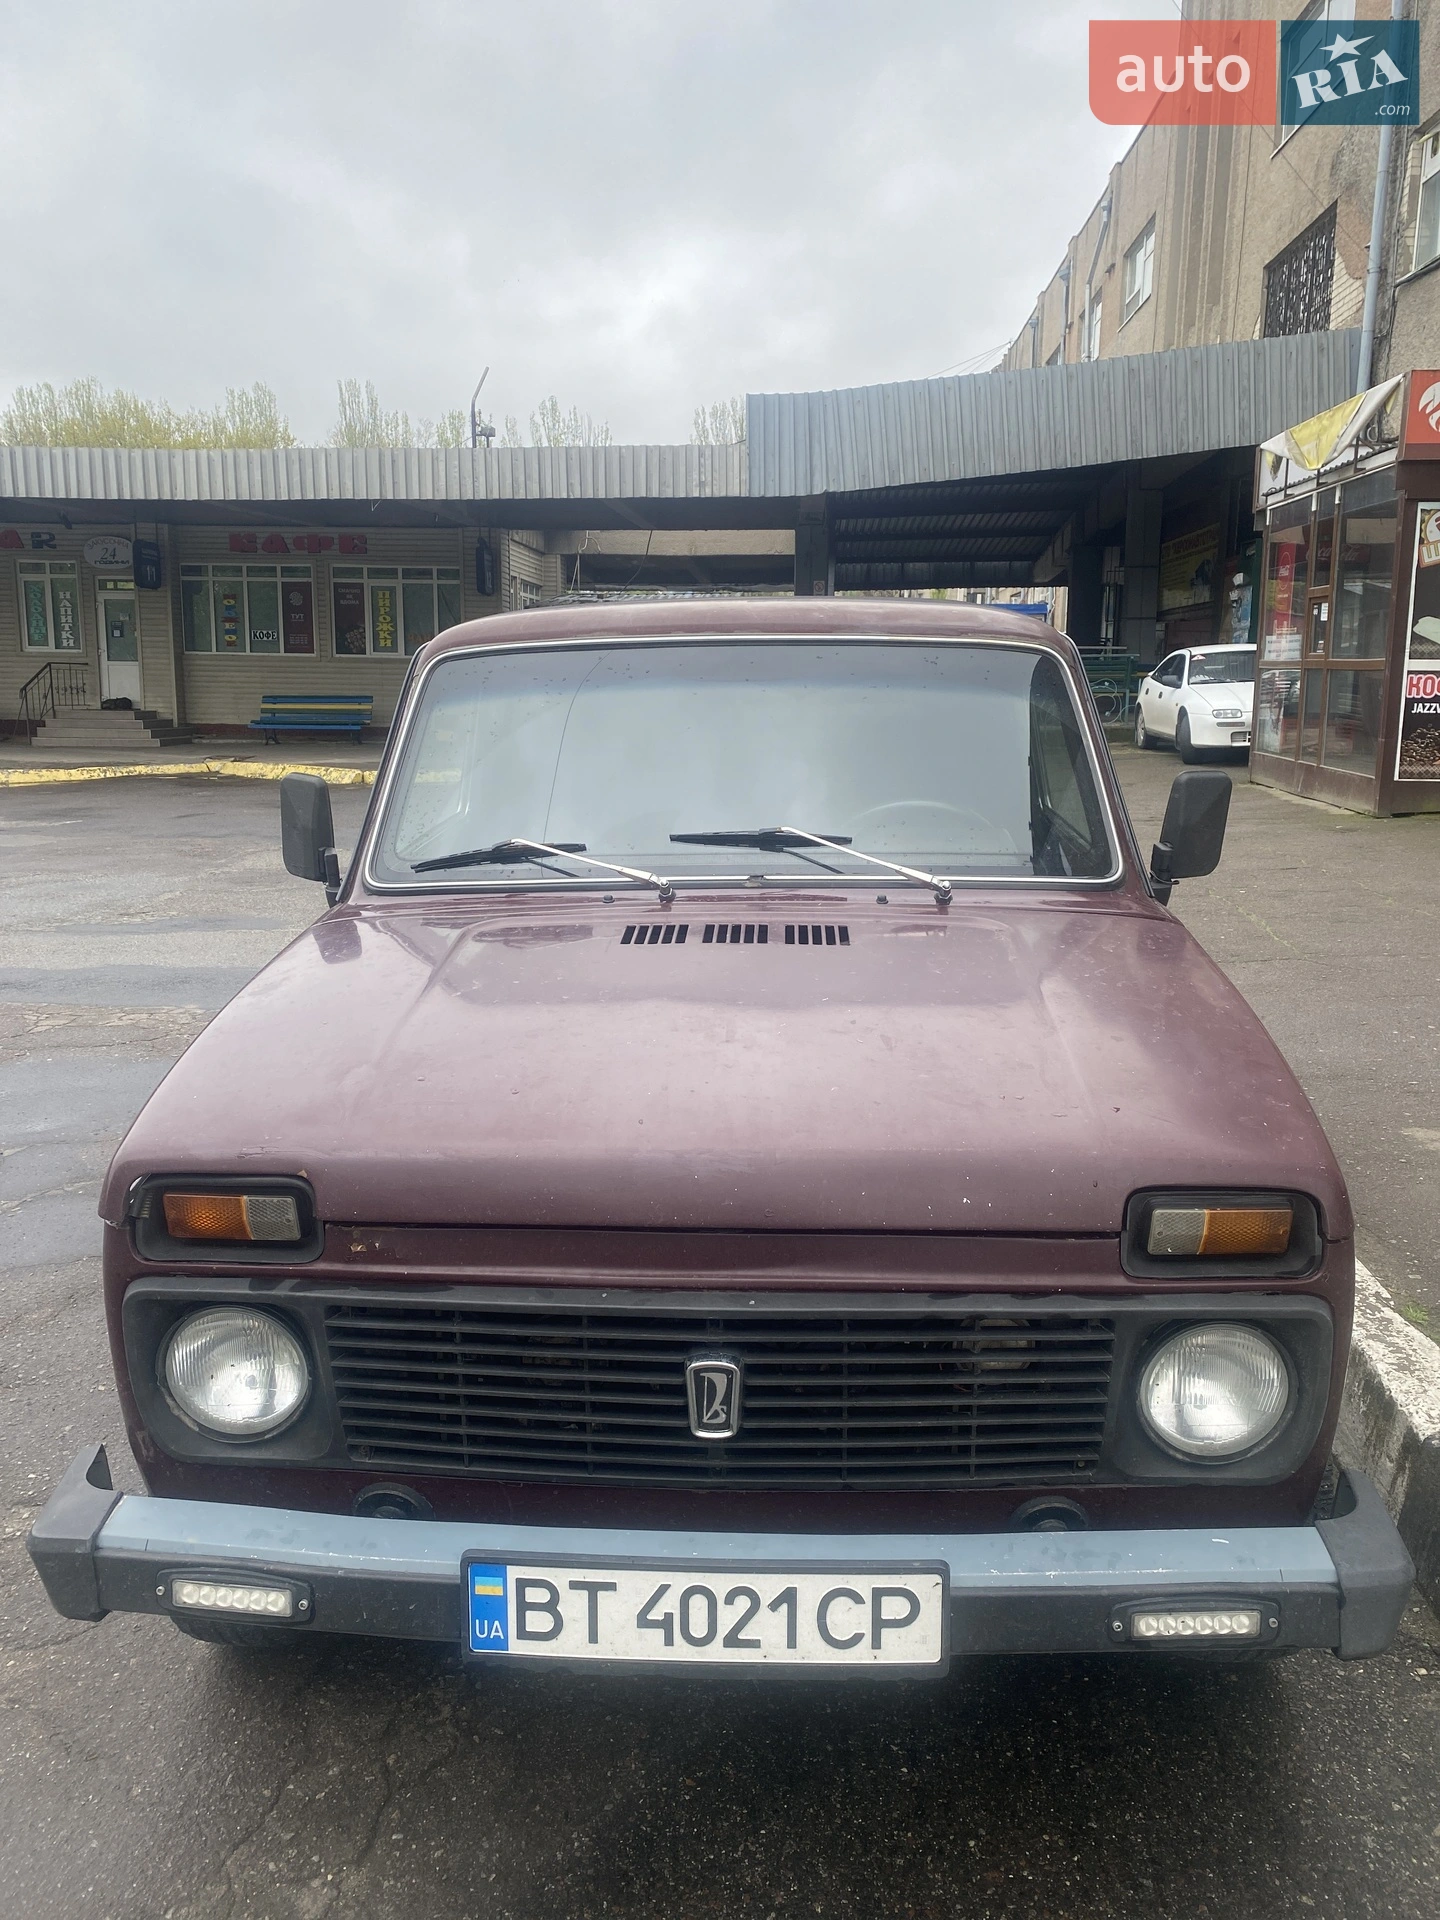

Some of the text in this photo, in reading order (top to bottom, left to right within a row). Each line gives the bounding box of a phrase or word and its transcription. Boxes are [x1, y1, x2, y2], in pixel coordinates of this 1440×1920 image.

[100, 547, 117, 560] 24
[229, 533, 368, 554] КАФЕ
[58, 591, 75, 647] НАПИТКИ
[376, 590, 395, 647] ПИРОЖКИ
[252, 630, 278, 641] КОФЕ
[1406, 674, 1440, 698] КО
[515, 1576, 921, 1651] BT 4021 CP
[474, 1619, 504, 1640] UA
